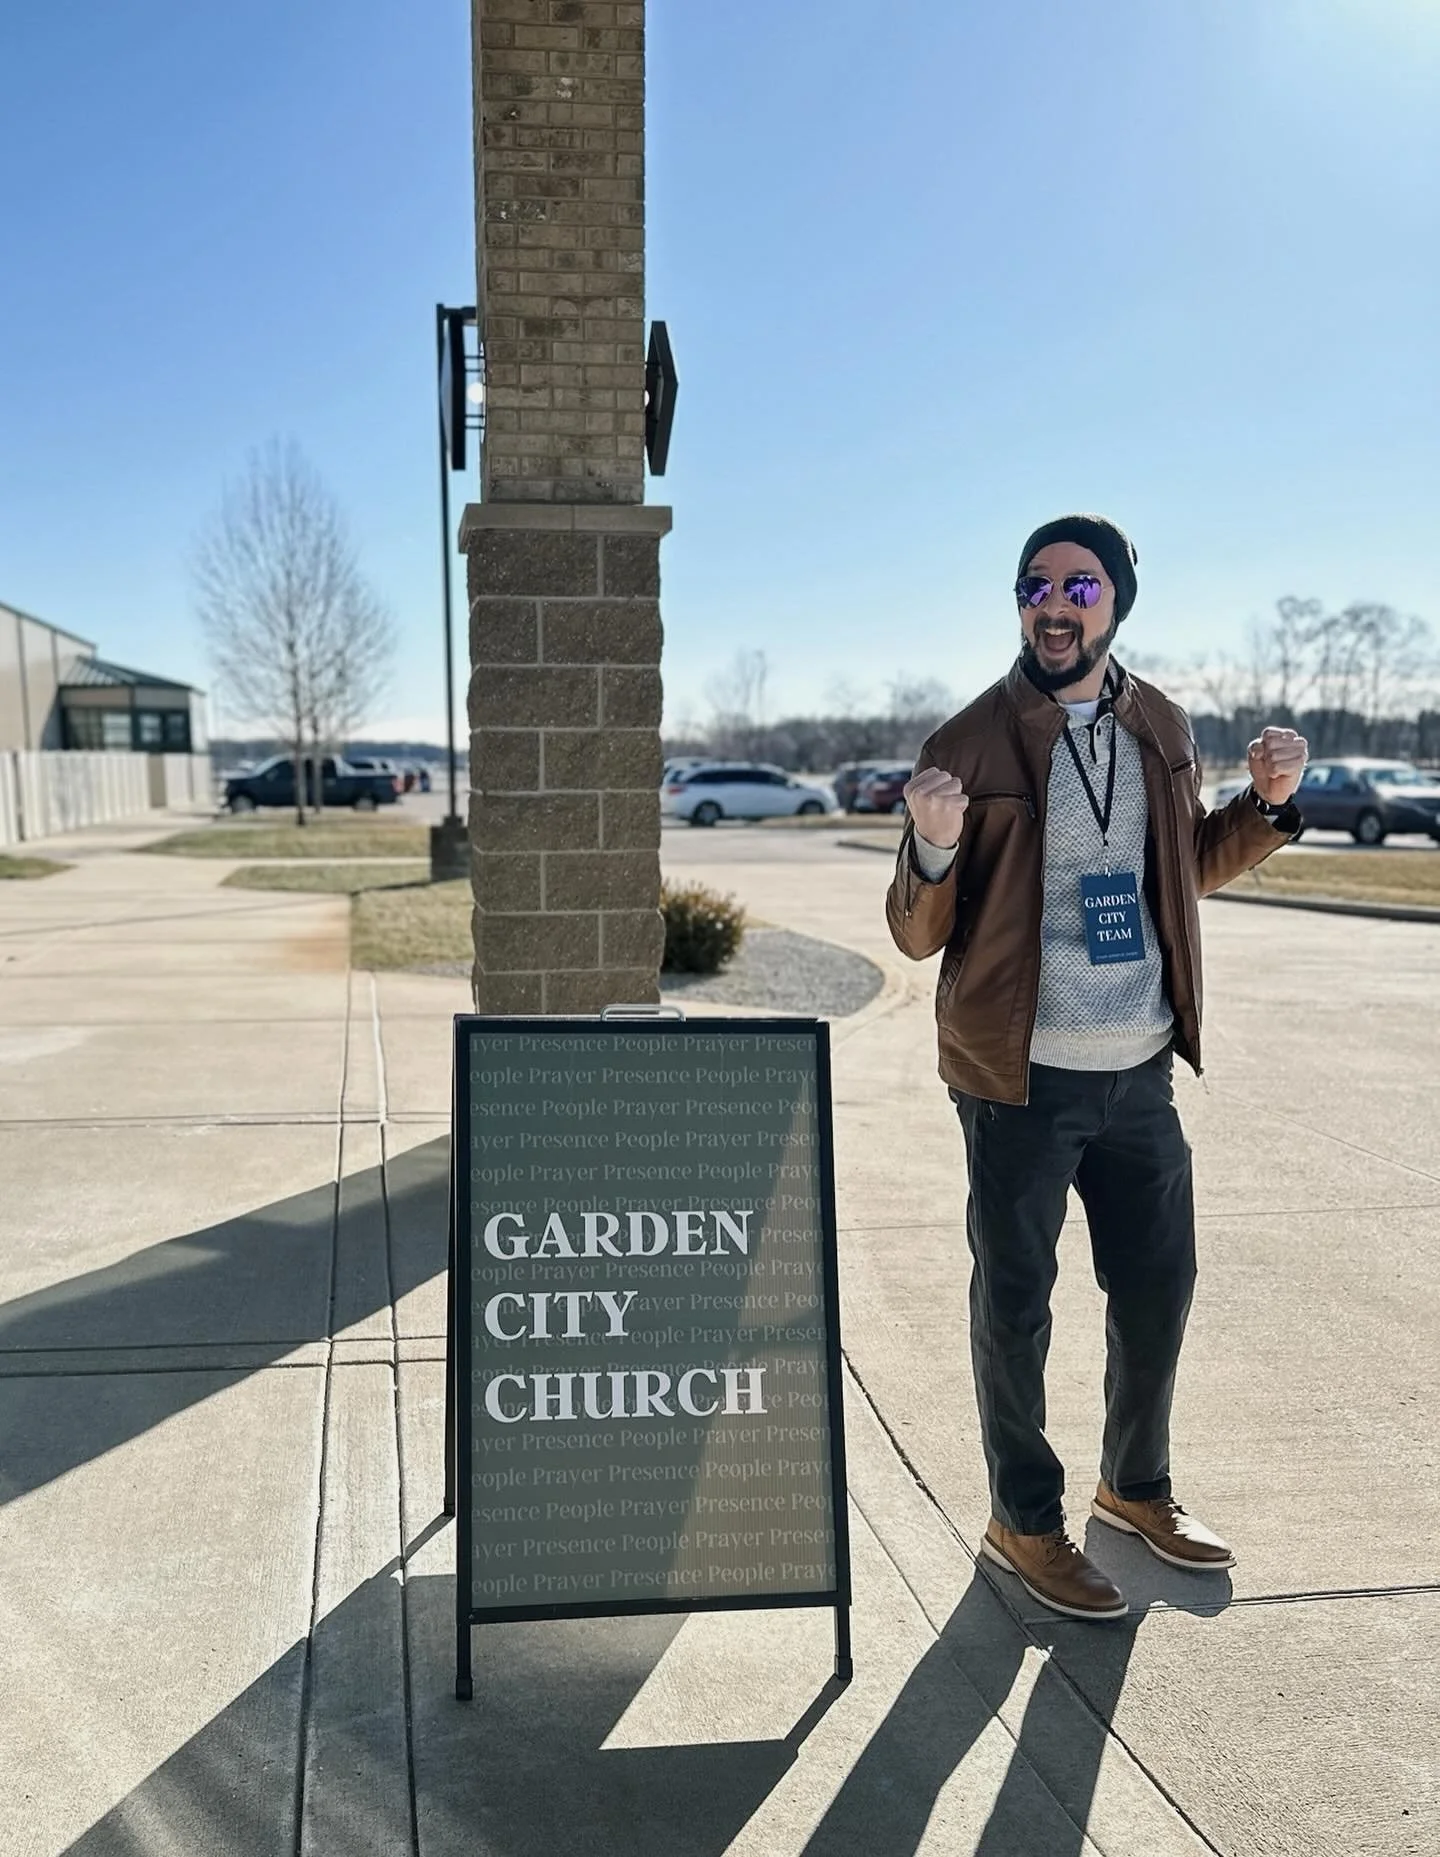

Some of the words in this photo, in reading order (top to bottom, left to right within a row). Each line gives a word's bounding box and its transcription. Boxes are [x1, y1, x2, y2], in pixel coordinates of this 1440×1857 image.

[1084, 893, 1136, 909] GARDEN
[1098, 911, 1127, 925] CITY
[1096, 928, 1132, 942] TEAM
[519, 1036, 608, 1052] Presence
[612, 1036, 678, 1056] People
[684, 1036, 749, 1056] Prayer
[529, 1067, 597, 1088] Prayer
[602, 1067, 690, 1084] Presence
[696, 1065, 760, 1088] People
[542, 1098, 607, 1120] People
[613, 1100, 680, 1121] Prayer
[686, 1100, 772, 1115] Presence
[520, 1132, 609, 1149] Presence
[615, 1130, 679, 1151] People
[686, 1131, 751, 1150] Prayer
[529, 1164, 598, 1186] Prayer
[603, 1164, 692, 1181] Presence
[698, 1161, 762, 1184] People
[484, 1209, 754, 1260] GARDEN
[531, 1263, 599, 1285] Prayer
[606, 1262, 694, 1279] Presence
[700, 1259, 765, 1281] People
[690, 1294, 779, 1311] Presence
[484, 1291, 638, 1340] CITY
[690, 1326, 757, 1346] Prayer
[484, 1368, 769, 1423] CHURCH
[522, 1433, 614, 1450] Presence
[621, 1426, 687, 1450] People
[693, 1427, 760, 1448] Prayer
[533, 1467, 603, 1489] Prayer
[608, 1464, 699, 1482] Presence
[706, 1459, 771, 1482] People
[546, 1498, 614, 1523] People
[621, 1499, 689, 1519] Prayer
[696, 1495, 785, 1514] Presence
[523, 1538, 616, 1556] Presence
[622, 1531, 689, 1554] People
[696, 1530, 764, 1550] Prayer
[534, 1572, 604, 1593] Prayer
[610, 1568, 703, 1588] Presence
[709, 1562, 775, 1586] People
